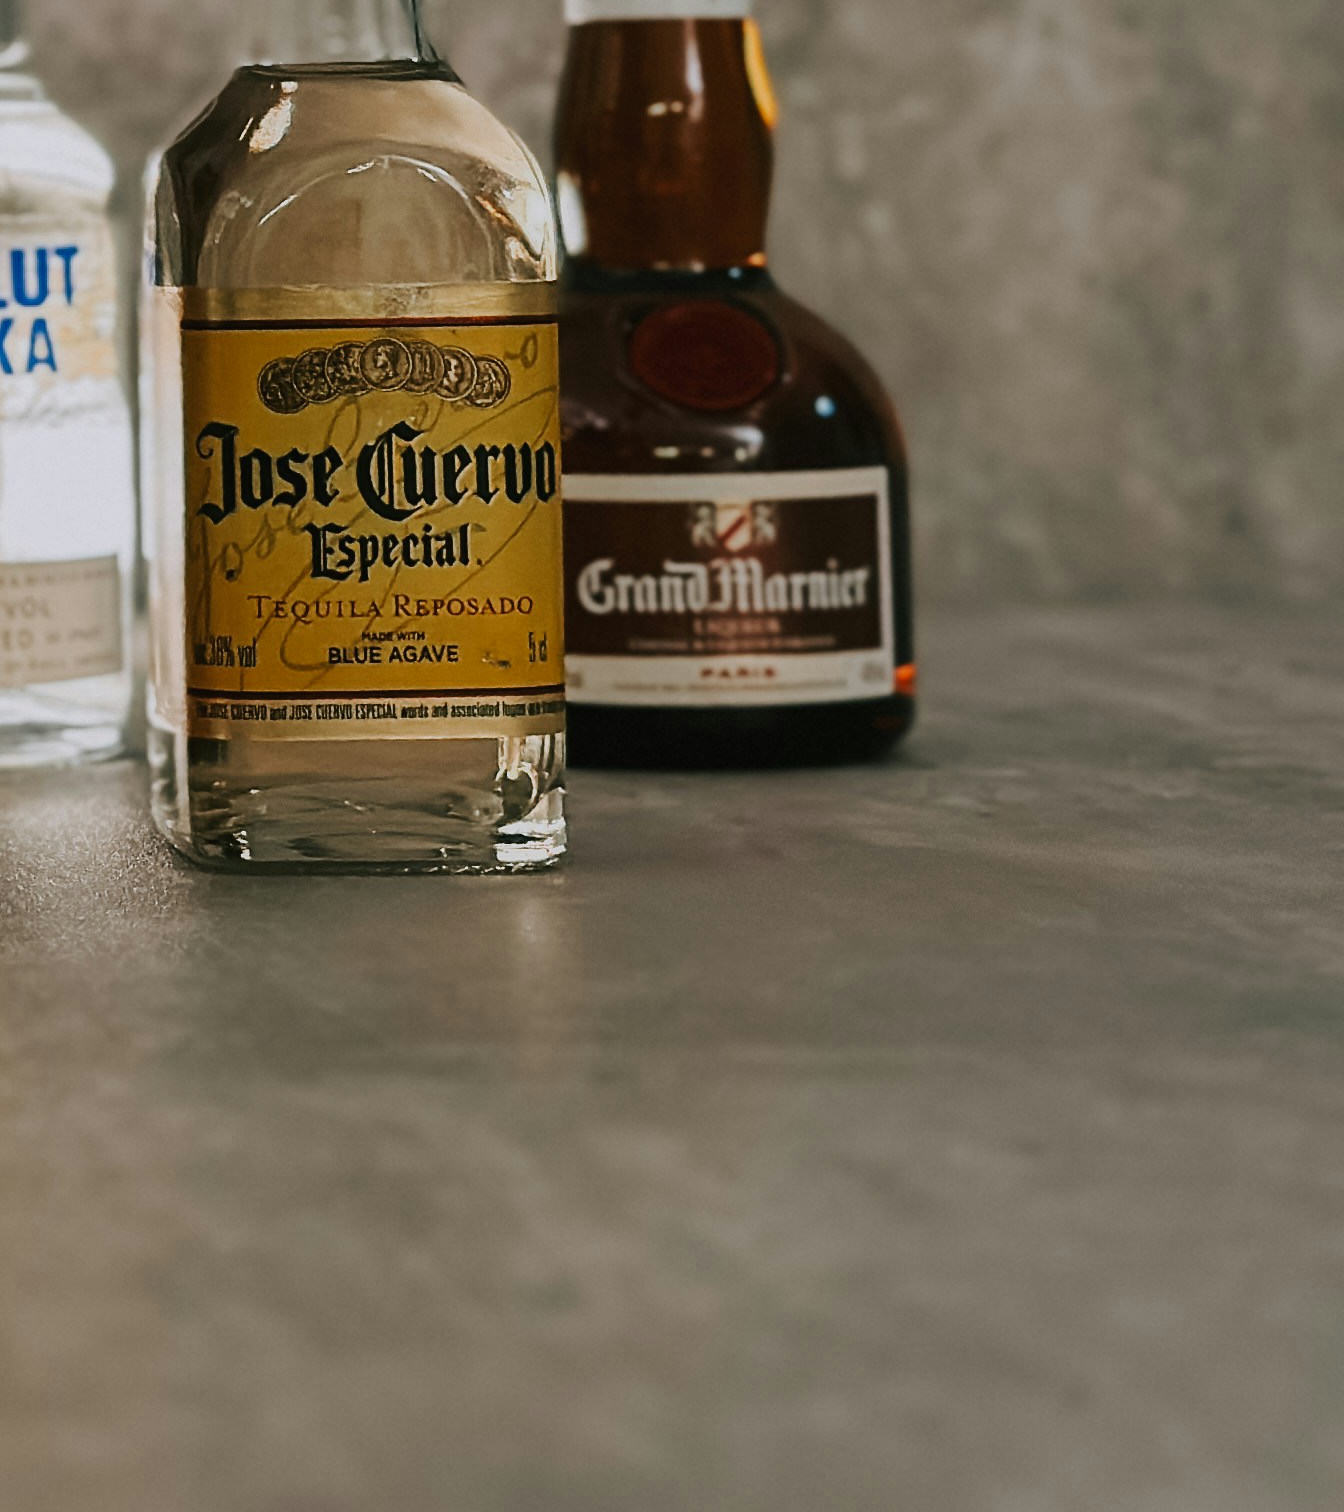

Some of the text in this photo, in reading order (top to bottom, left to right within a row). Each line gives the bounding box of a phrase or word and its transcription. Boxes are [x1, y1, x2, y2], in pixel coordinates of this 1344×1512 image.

[196, 418, 557, 526] Jose Cuervo
[577, 555, 871, 615] Grand Marnier
[361, 630, 426, 643] MADE WITH
[327, 644, 460, 665] BLUE AGAVE
[288, 704, 313, 720] JOSE
[315, 703, 353, 720] CUERVO
[355, 702, 398, 720] ESPECIAL
[400, 702, 429, 719] words
[431, 701, 449, 718] and
[450, 701, 500, 718] associated
